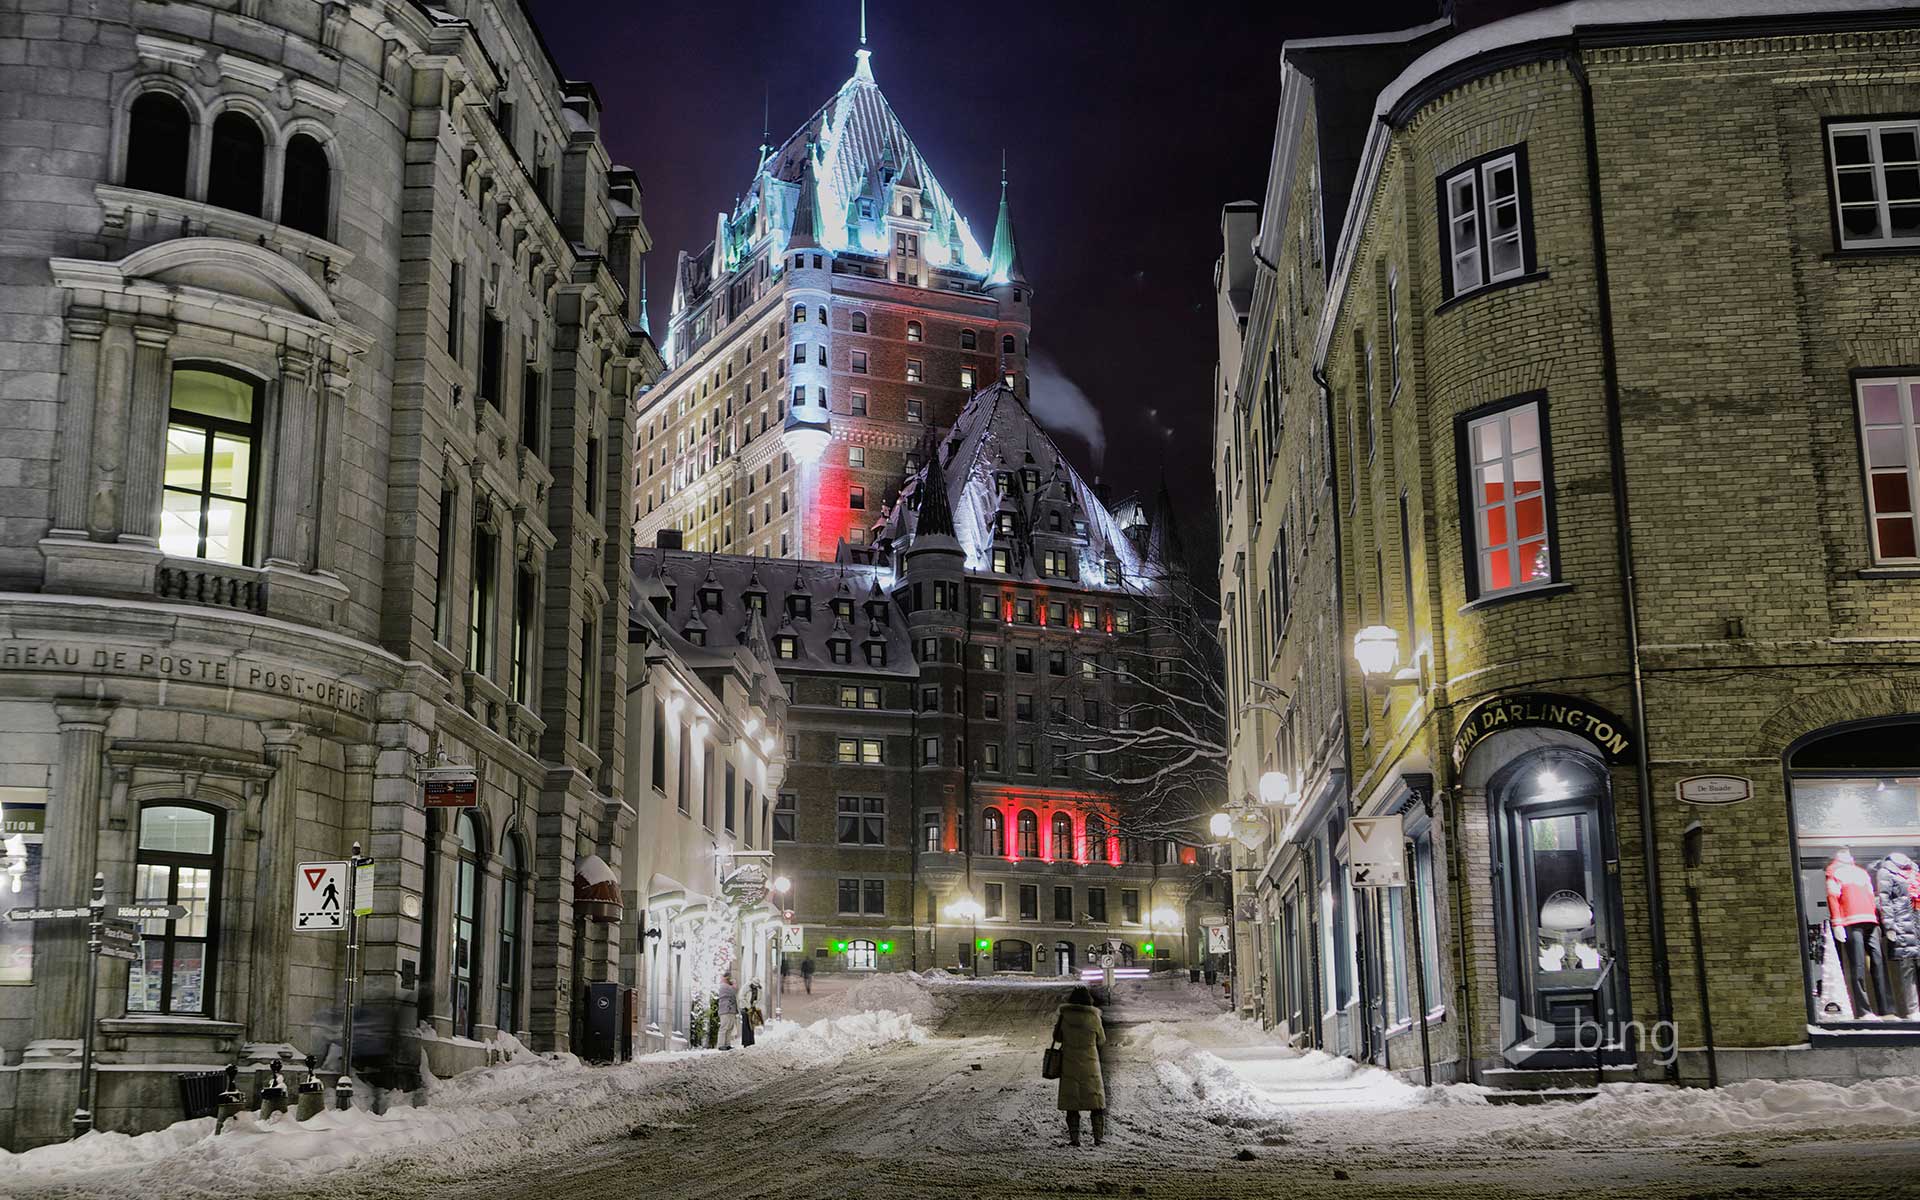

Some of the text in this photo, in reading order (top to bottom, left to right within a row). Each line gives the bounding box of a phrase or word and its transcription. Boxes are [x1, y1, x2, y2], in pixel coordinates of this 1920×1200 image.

[3, 646, 365, 712] REAU DE POSTE POST-OFFICE
[1481, 703, 1630, 756] DARLINGTON
[118, 906, 170, 917] Hôtel de ville
